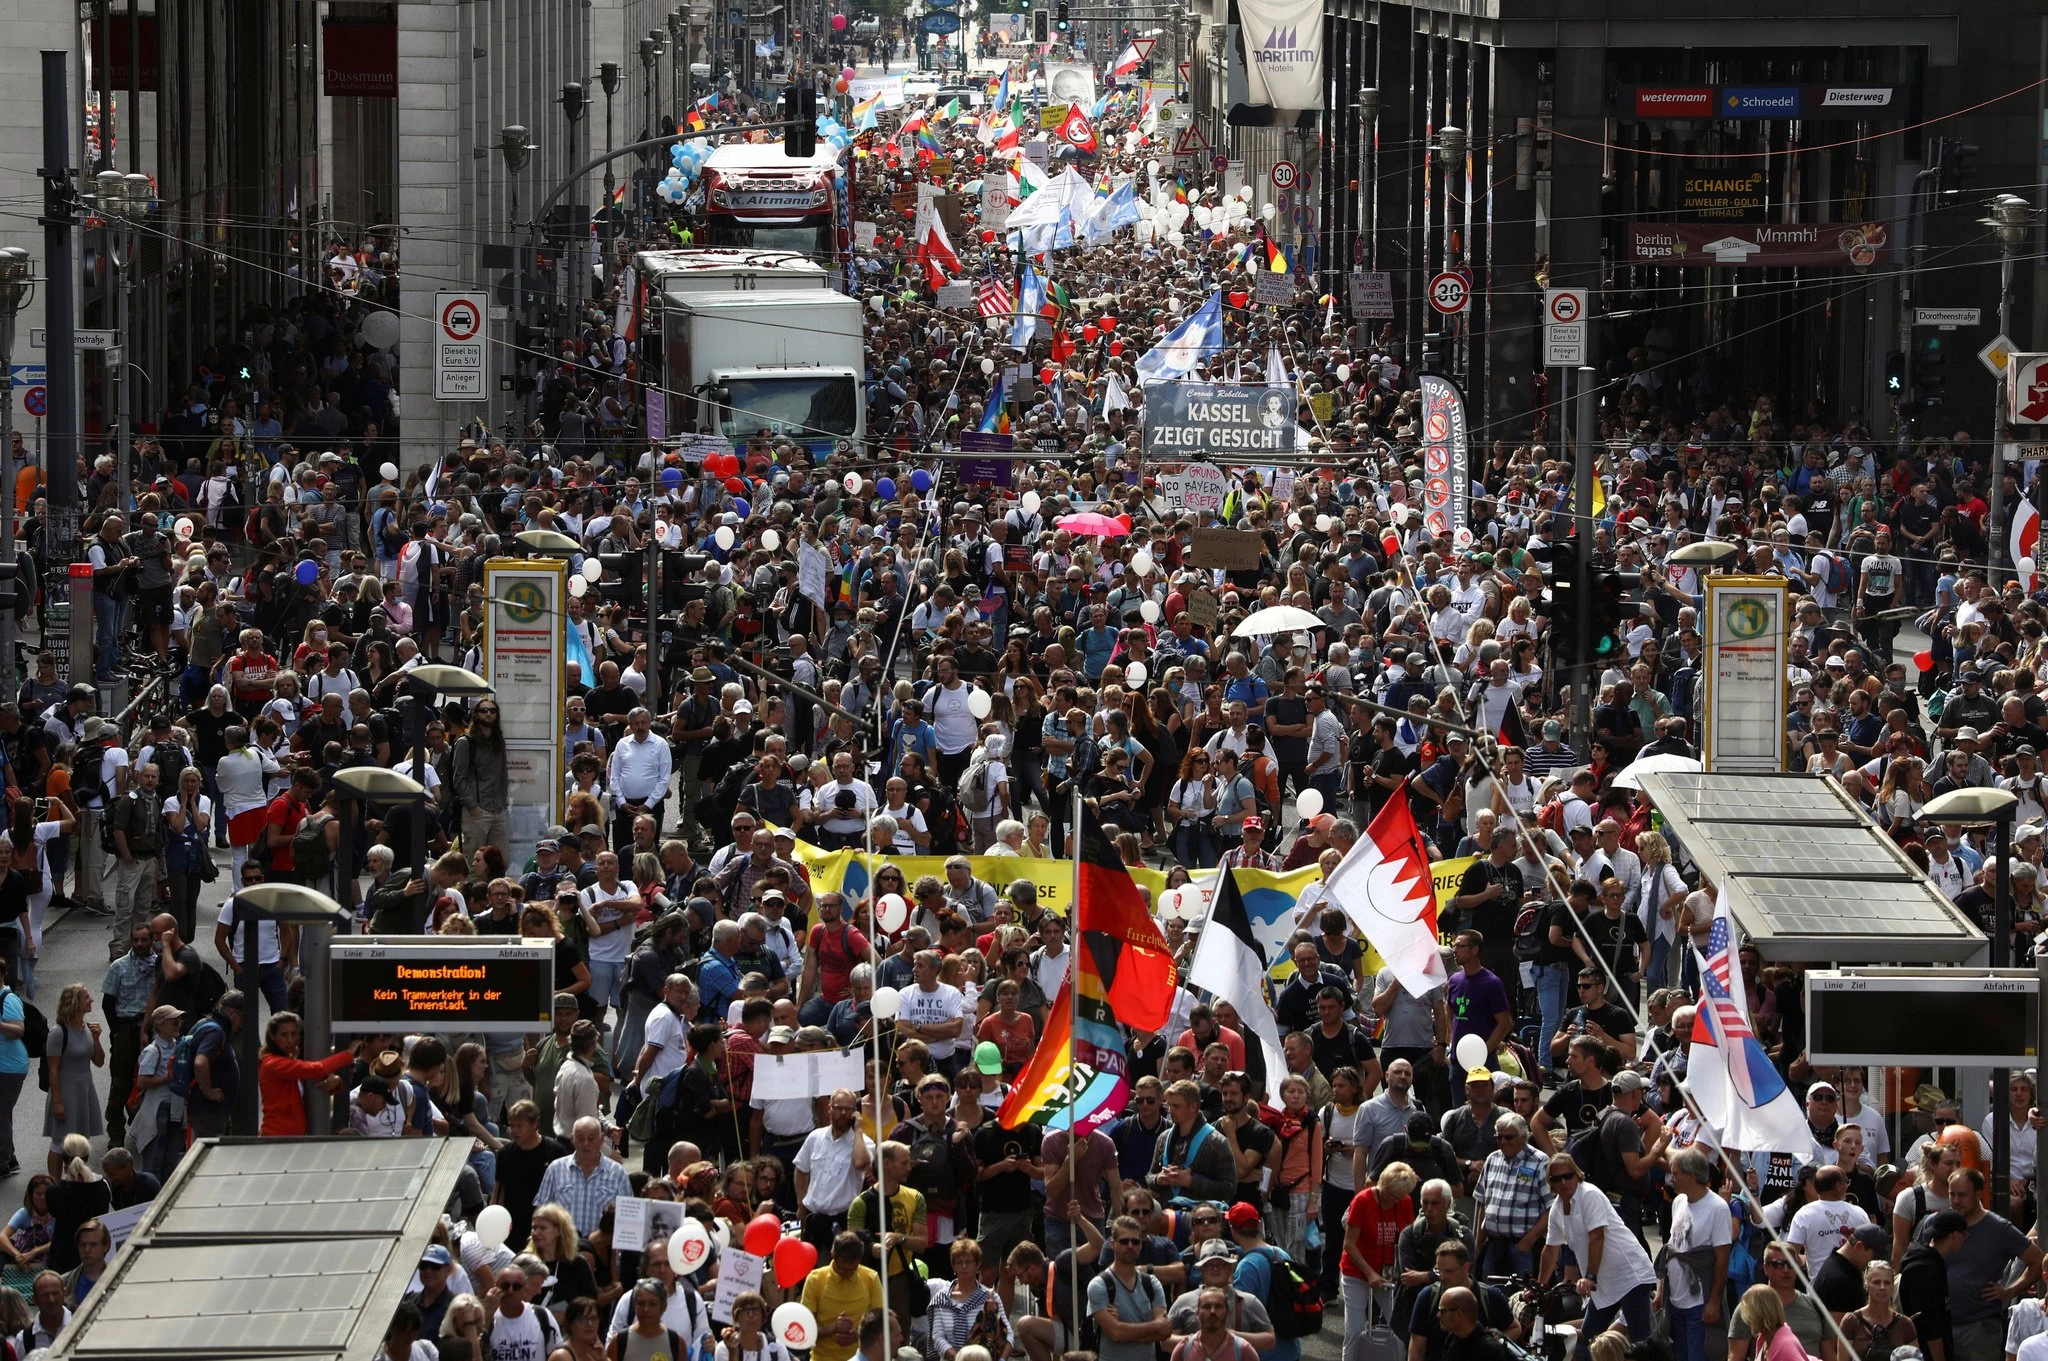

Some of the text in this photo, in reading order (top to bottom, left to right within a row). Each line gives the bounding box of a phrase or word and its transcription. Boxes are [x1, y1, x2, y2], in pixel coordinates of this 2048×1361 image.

[1253, 50, 1314, 62] MARITIM
[327, 69, 394, 82] Dussmann
[1641, 93, 1707, 102] westermann
[1742, 97, 1794, 107] Schroedel
[1829, 92, 1884, 104] Diesterweg
[1276, 168, 1291, 182] 30
[731, 195, 810, 206] K. Altmann
[1684, 198, 1759, 208] JUWELIER GOLD
[1698, 209, 1744, 217] LEIHHAUS
[1636, 233, 1672, 245] berlin
[1756, 228, 1818, 243] Mmmh!
[1636, 246, 1672, 258] tapas
[1351, 273, 1384, 281] POLITIKER
[1438, 284, 1461, 302] 30
[1919, 312, 1976, 322] Dorotheenstraße
[444, 347, 478, 355] Diesel bis
[445, 357, 477, 365] Euro 5/V
[446, 374, 476, 382] Anlieger
[454, 383, 468, 391] frei
[1186, 388, 1249, 399] Corona Rebellen
[1187, 402, 1251, 423] KASSEL
[1153, 426, 1283, 449] ZEIGT GESICHT
[1188, 466, 1220, 480] GRUND
[1184, 480, 1223, 495] BAYERN
[1184, 491, 1219, 508] GESETZ
[1867, 560, 1893, 570] MIAMI
[344, 950, 539, 958] Linie Ziel Abfahrt in
[397, 965, 486, 979] Demonstration!
[1824, 981, 2025, 991] Linie Ziel Abfahrt in
[373, 989, 502, 1000] Kein Tramverkehr in der
[409, 1000, 468, 1010] Innenstadt.
[917, 998, 943, 1009] NYC
[491, 1347, 531, 1361] BERLIN
